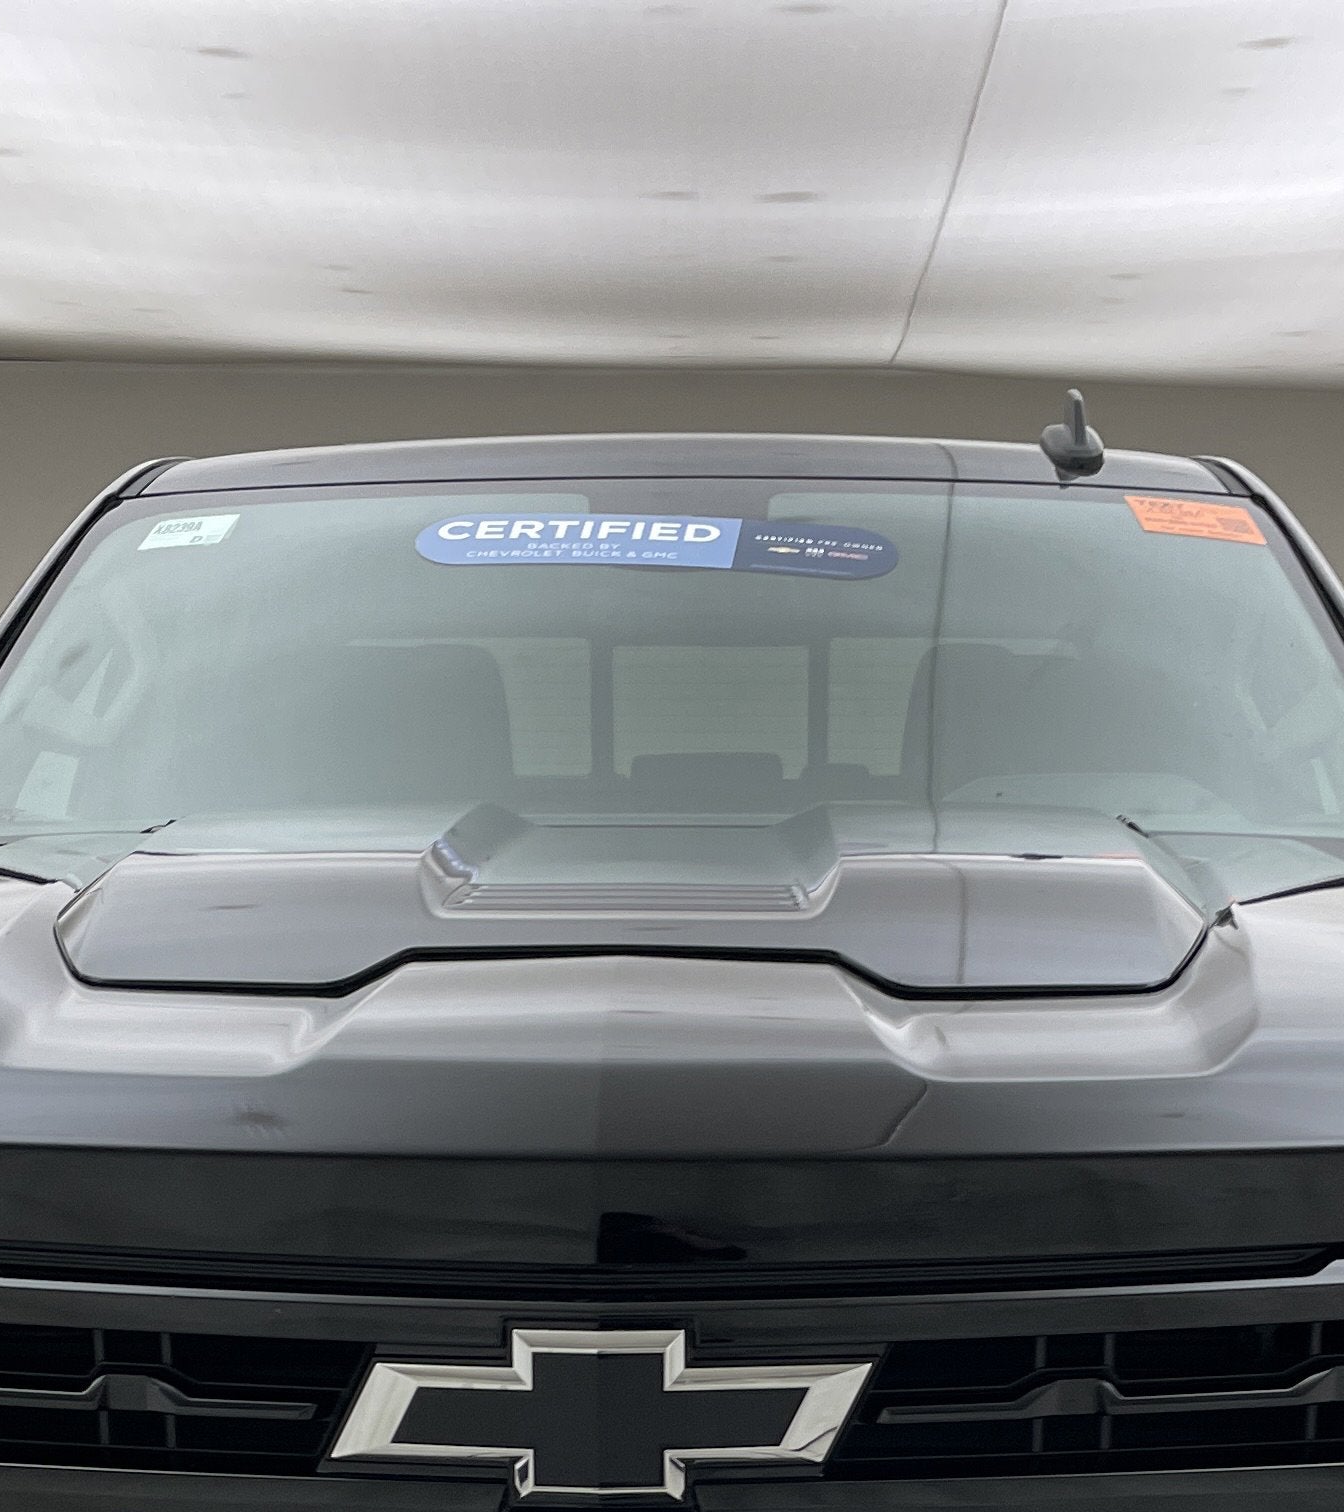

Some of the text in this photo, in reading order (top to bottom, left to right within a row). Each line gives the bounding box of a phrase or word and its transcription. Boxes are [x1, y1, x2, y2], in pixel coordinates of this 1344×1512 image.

[437, 520, 721, 543] CERTIFIED
[527, 543, 622, 552] BACKED BY
[466, 549, 564, 559] CHEVROLET
[571, 550, 622, 559] BUICK
[641, 551, 679, 560] GMC
